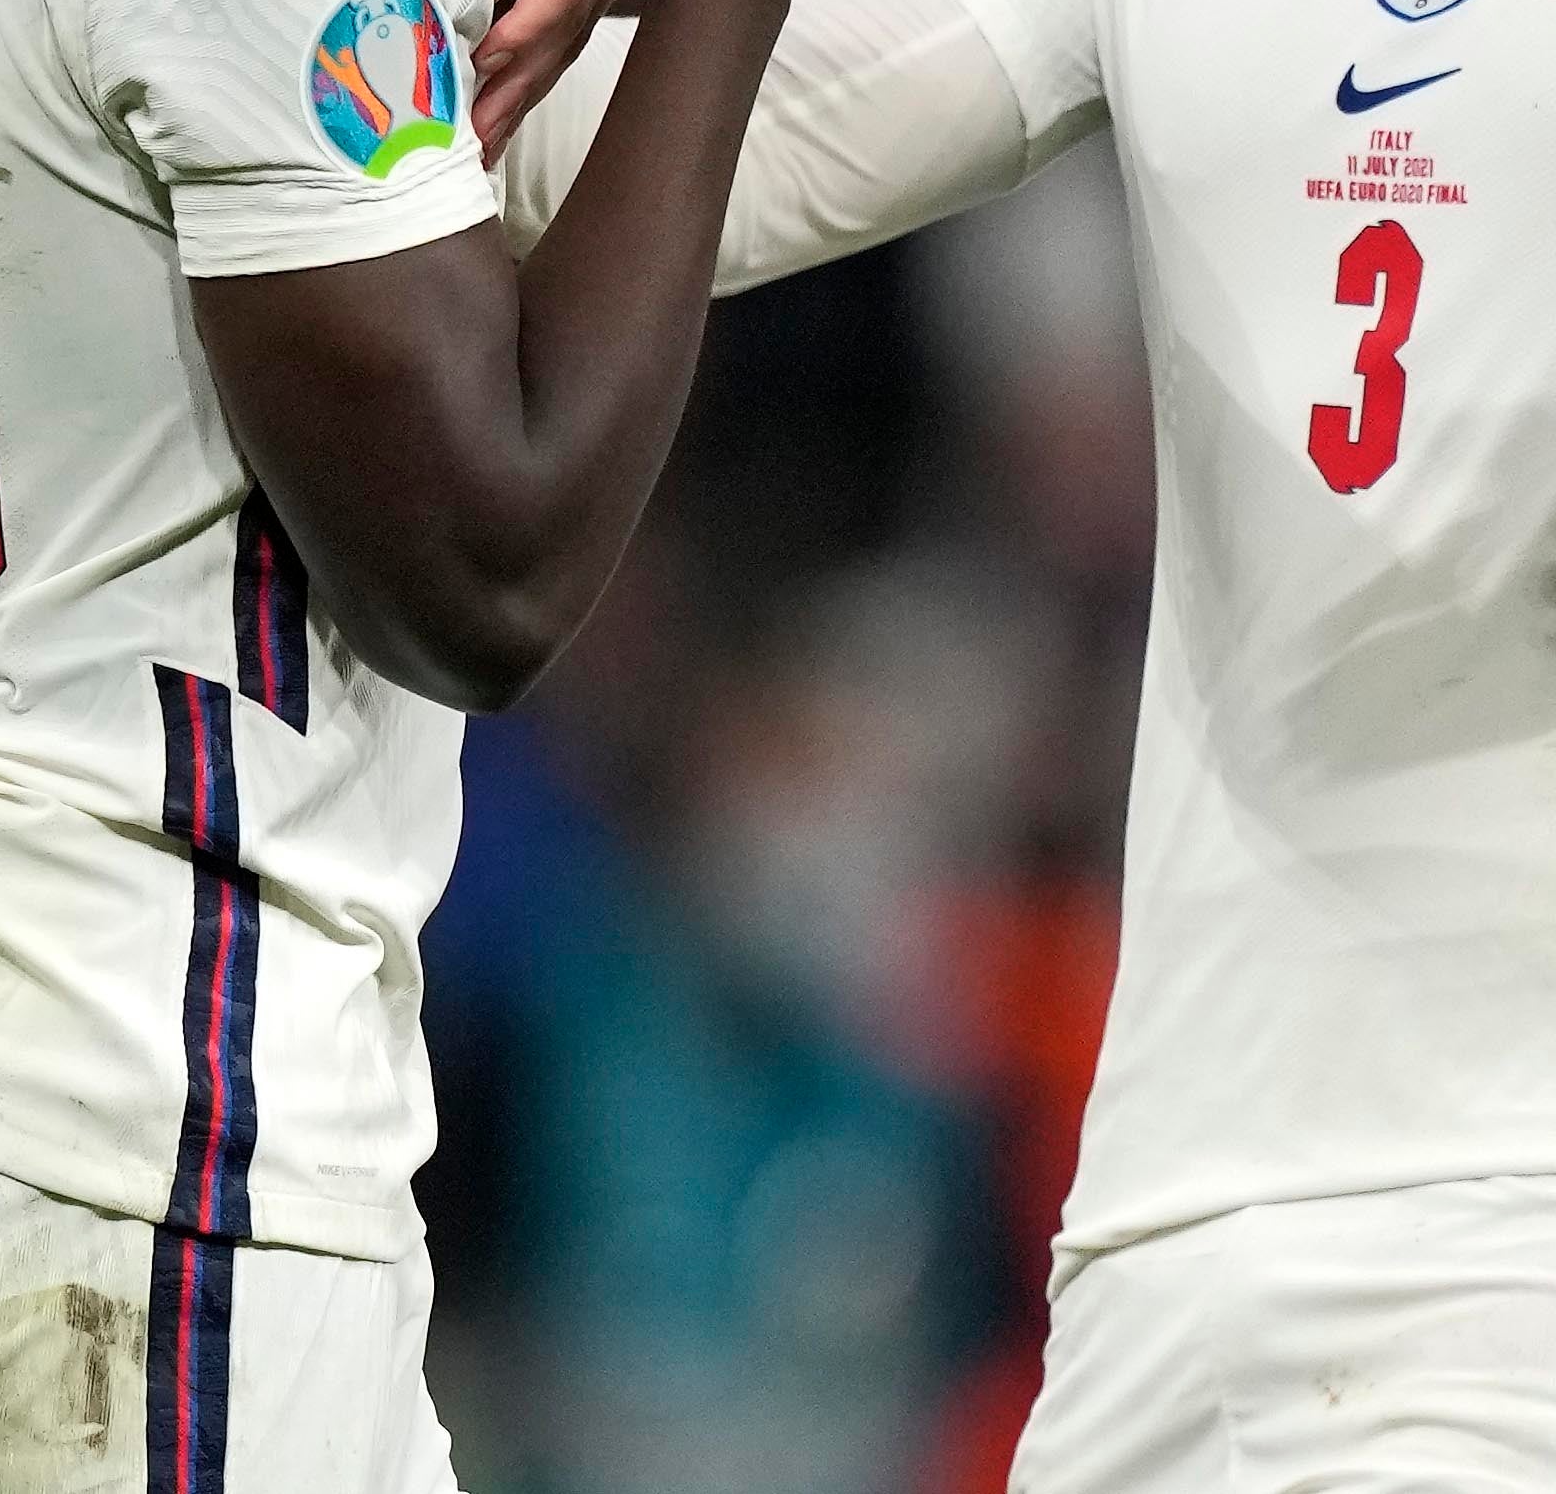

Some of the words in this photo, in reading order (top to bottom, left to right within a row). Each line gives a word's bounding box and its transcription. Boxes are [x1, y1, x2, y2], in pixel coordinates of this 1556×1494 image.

[1369, 129, 1413, 151] ITALY
[1347, 155, 1358, 177] 11
[1362, 155, 1399, 178] JULY
[1403, 157, 1434, 179] 2021
[1307, 179, 1344, 201] UEFA
[1349, 181, 1387, 203] EURO
[1391, 182, 1423, 204] 2020
[1427, 183, 1469, 205] FINAL
[1308, 219, 1424, 494] 3
